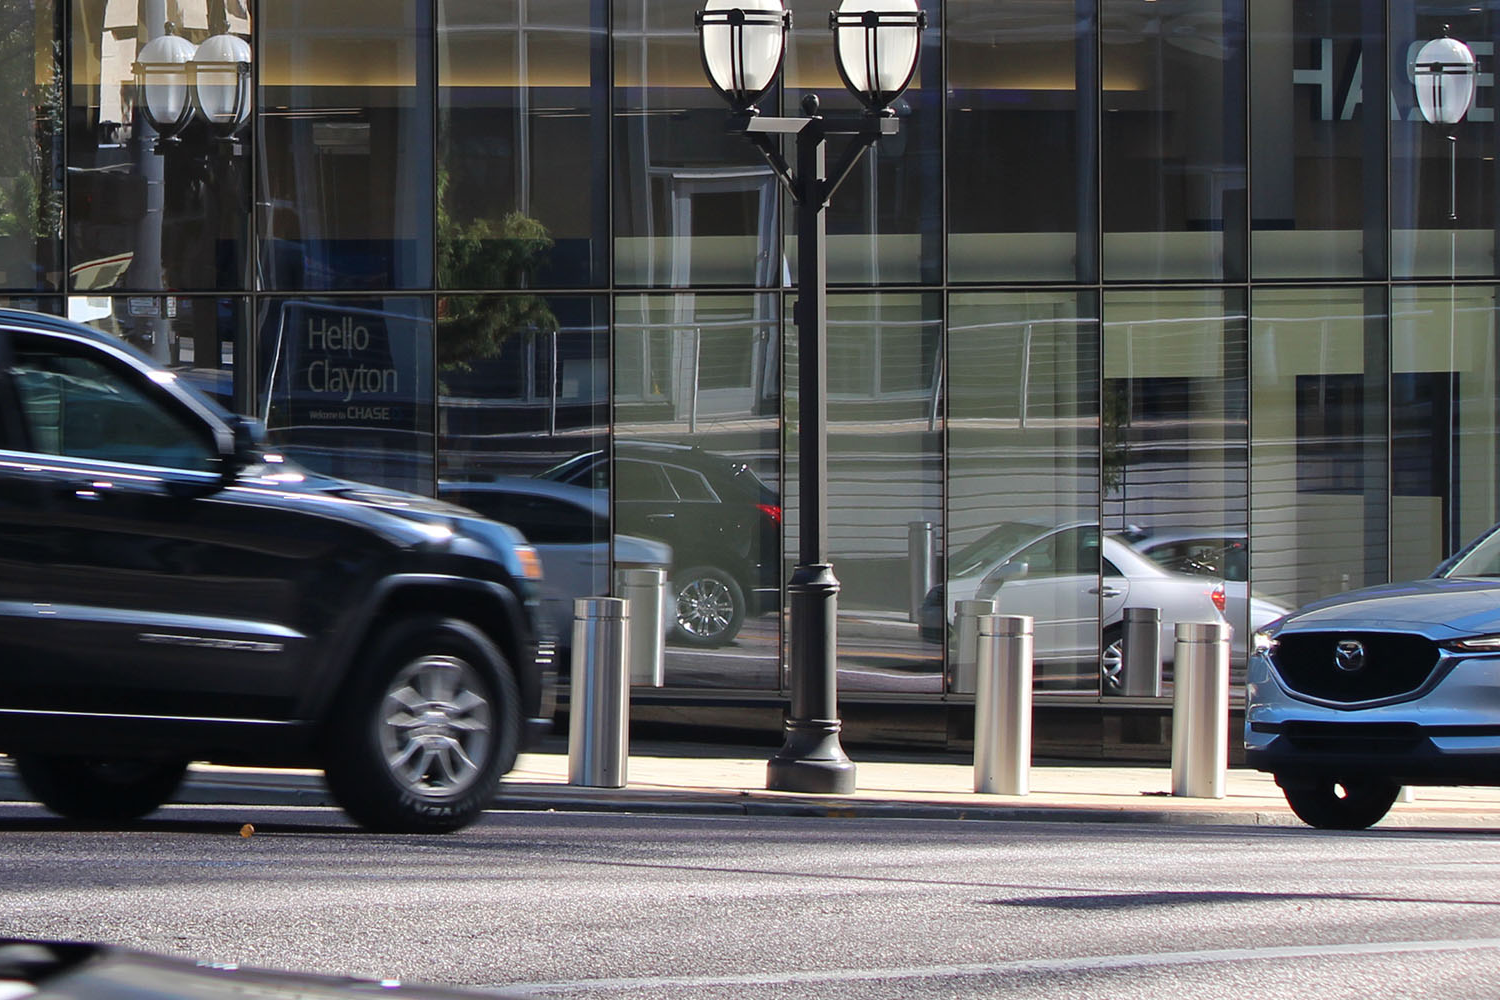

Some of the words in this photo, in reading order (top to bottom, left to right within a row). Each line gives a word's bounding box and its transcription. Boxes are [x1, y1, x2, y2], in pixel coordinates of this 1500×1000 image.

[308, 316, 369, 350] Hello
[307, 359, 398, 402] Clayton
[347, 406, 390, 420] CHASE
